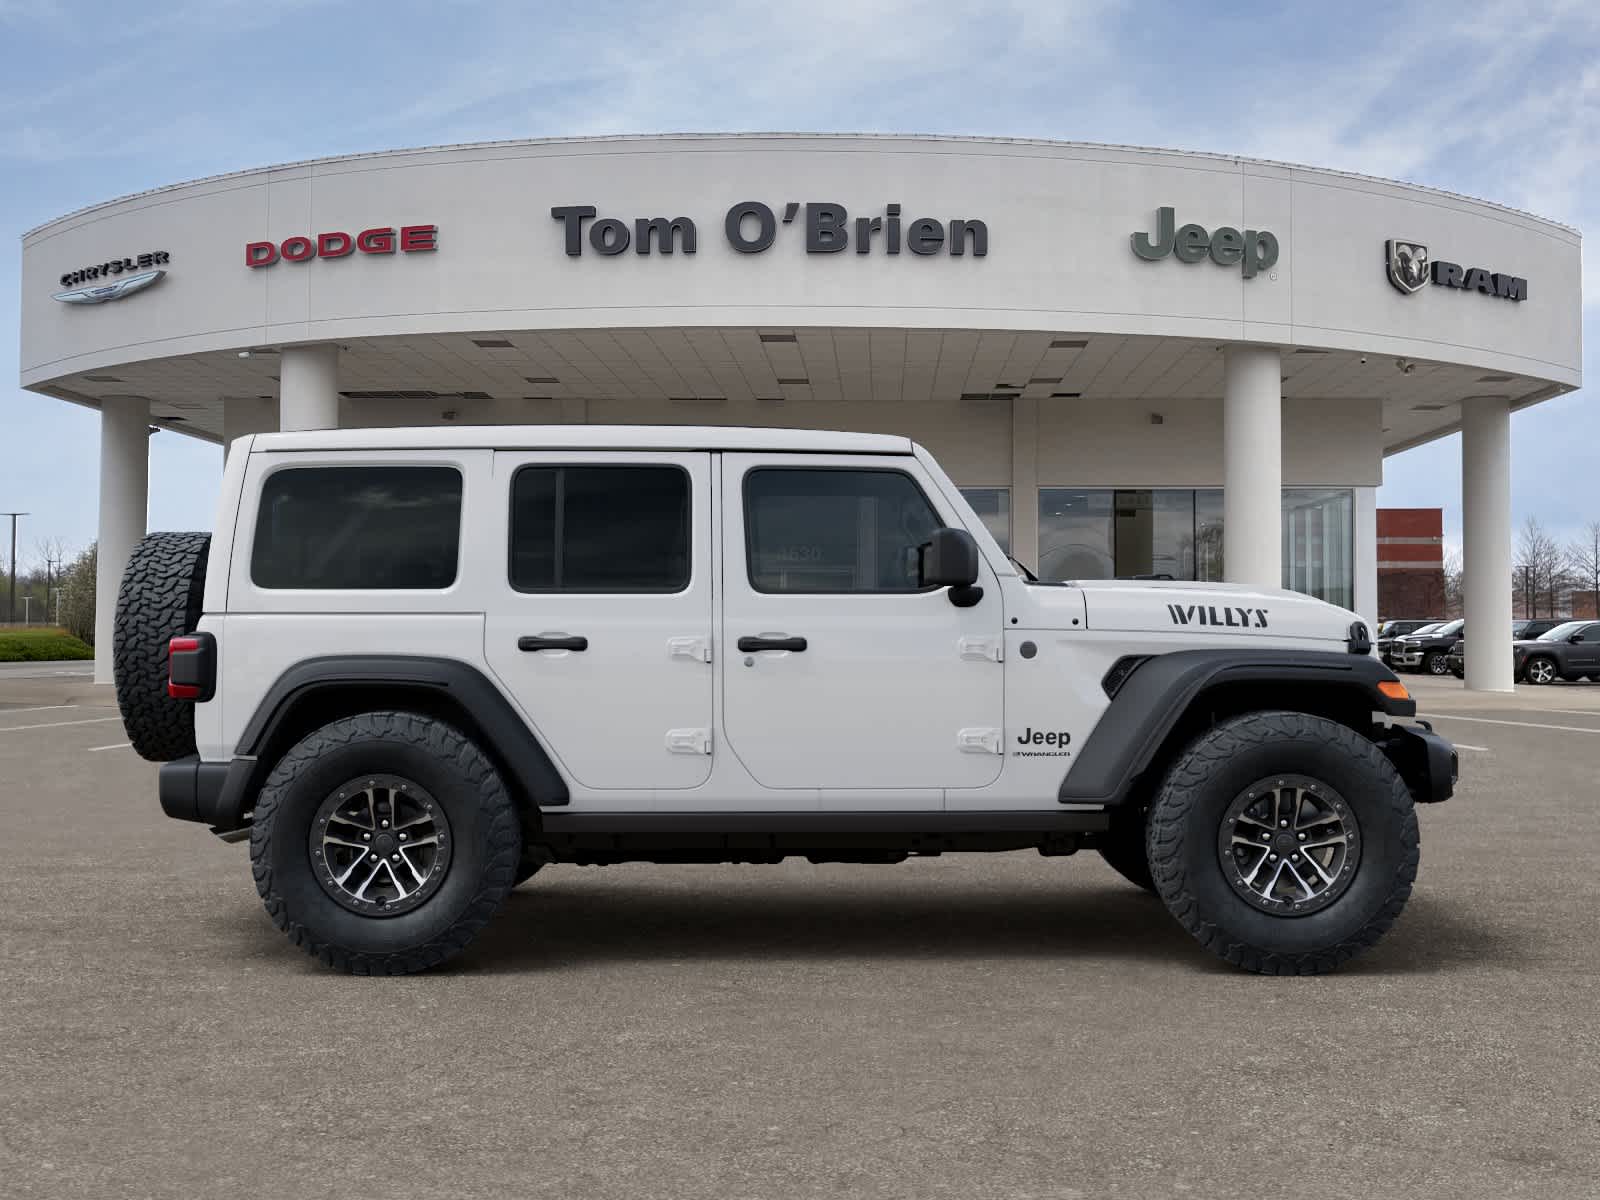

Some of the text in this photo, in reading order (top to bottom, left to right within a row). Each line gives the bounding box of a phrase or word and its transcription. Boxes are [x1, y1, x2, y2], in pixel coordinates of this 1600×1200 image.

[245, 224, 438, 268] DODGE
[551, 201, 988, 257] Tom O'Brien
[1130, 206, 1280, 279] Jeep
[60, 250, 170, 287] CHRYSLER
[1431, 260, 1528, 301] RAM
[1167, 604, 1269, 628] WILLYS
[1017, 727, 1071, 748] Jeep
